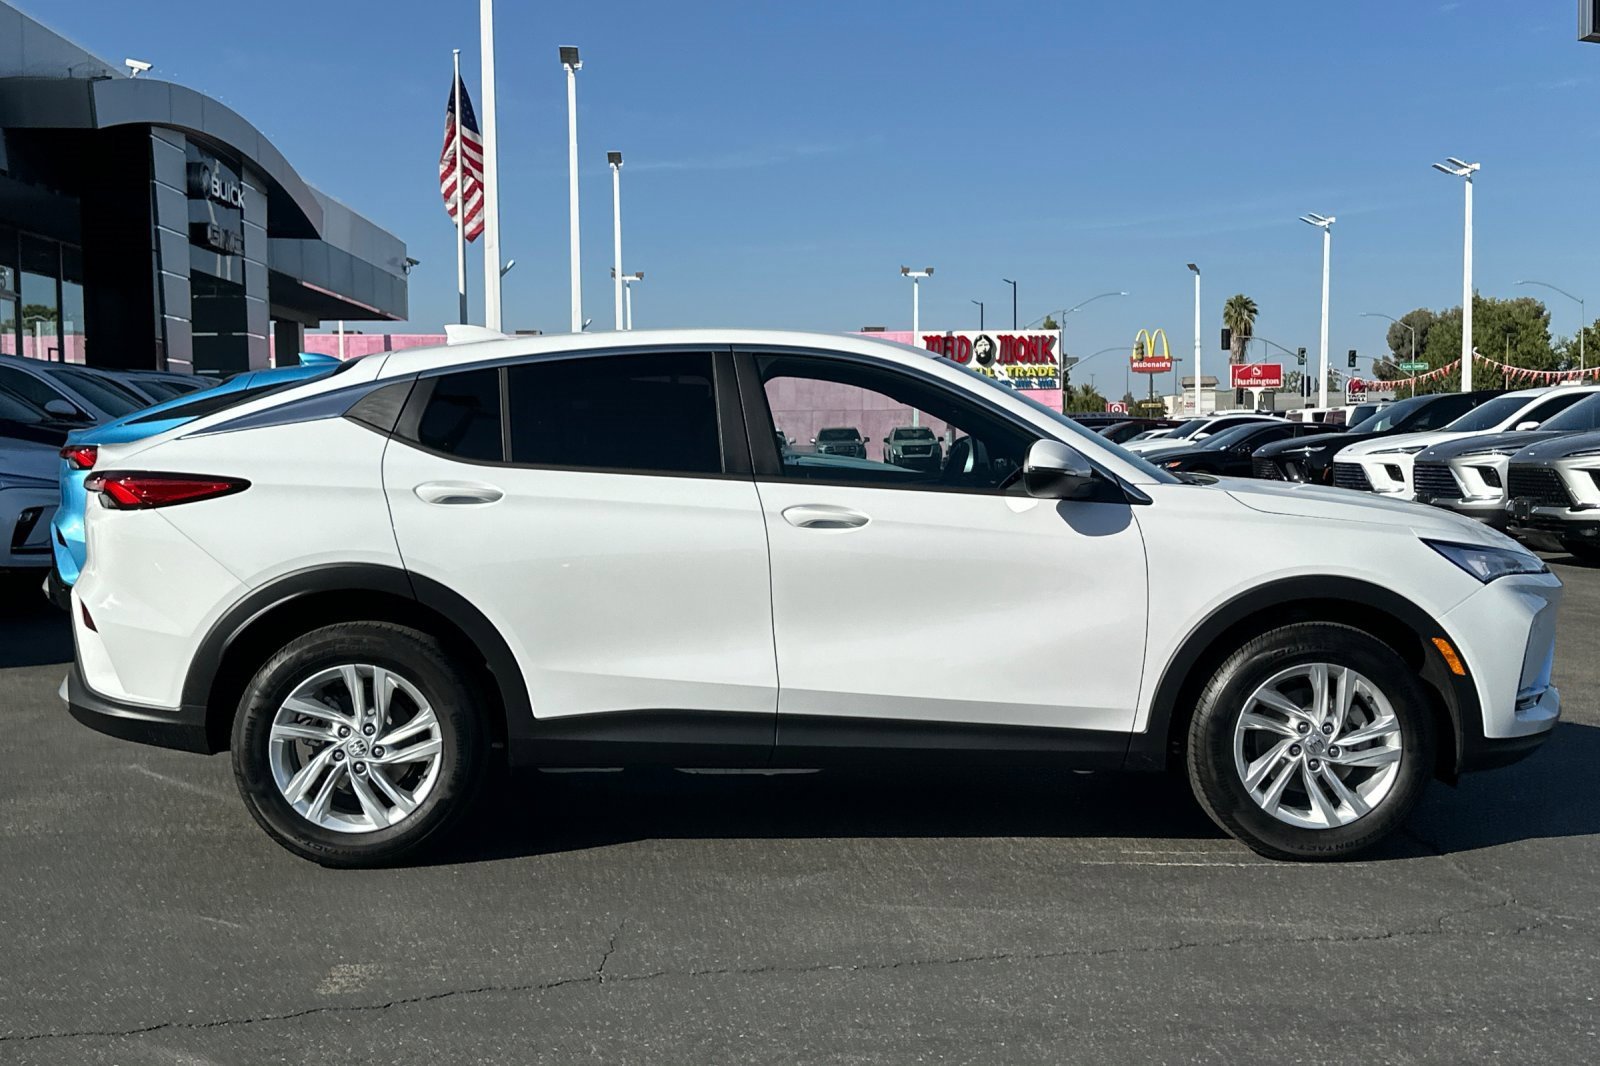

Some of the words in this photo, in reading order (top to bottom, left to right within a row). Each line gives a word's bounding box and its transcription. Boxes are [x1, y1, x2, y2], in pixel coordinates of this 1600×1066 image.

[211, 177, 245, 208] BUICK
[208, 223, 245, 256] GMC
[922, 335, 973, 364] MAD
[996, 335, 1058, 365] MONK
[1006, 367, 1056, 377] TRADE
